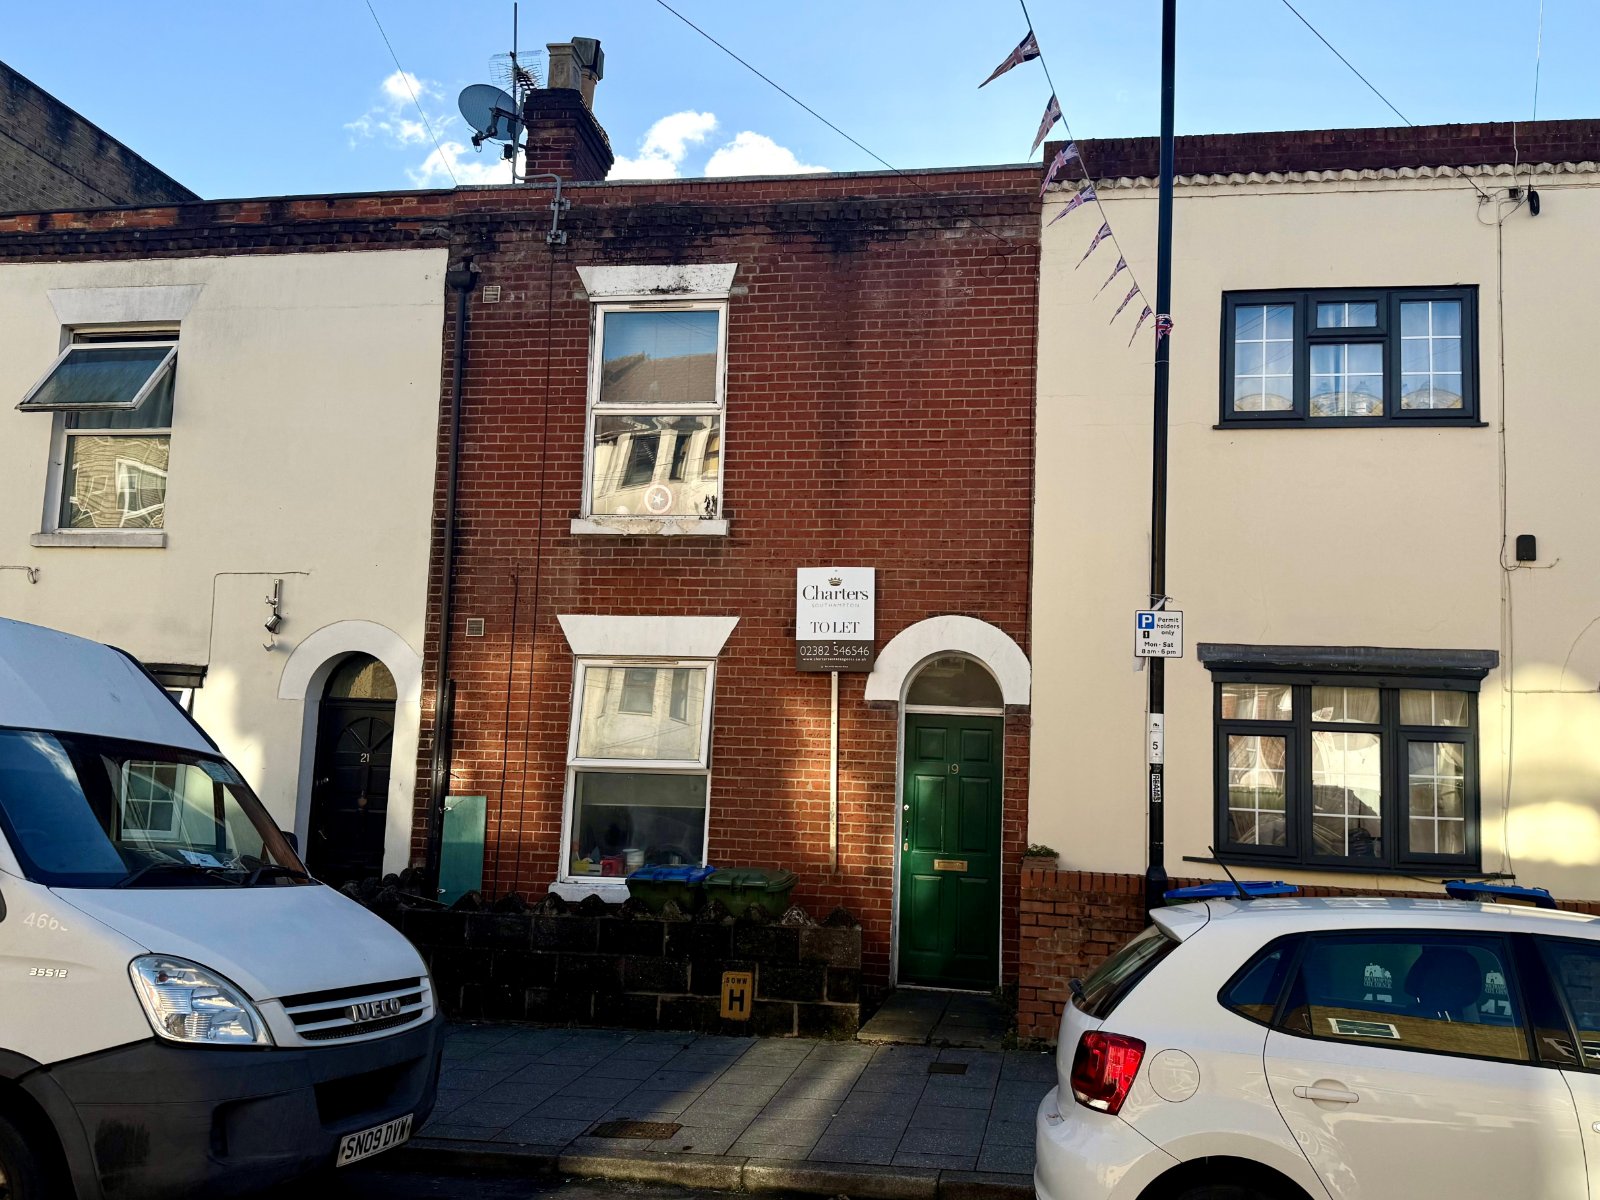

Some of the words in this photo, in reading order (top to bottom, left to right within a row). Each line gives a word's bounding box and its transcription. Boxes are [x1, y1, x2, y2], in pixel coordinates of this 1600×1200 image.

[802, 584, 869, 601] Charters
[810, 621, 830, 634] TO
[833, 621, 860, 634] LET
[1141, 614, 1153, 628] P
[800, 645, 830, 656] 02382
[833, 645, 870, 656] 546546
[1152, 741, 1159, 750] 5
[360, 752, 370, 763] 21
[947, 763, 959, 775] 19
[728, 989, 744, 1011] H
[351, 998, 401, 1022] IVECO
[344, 1128, 383, 1160] SN09
